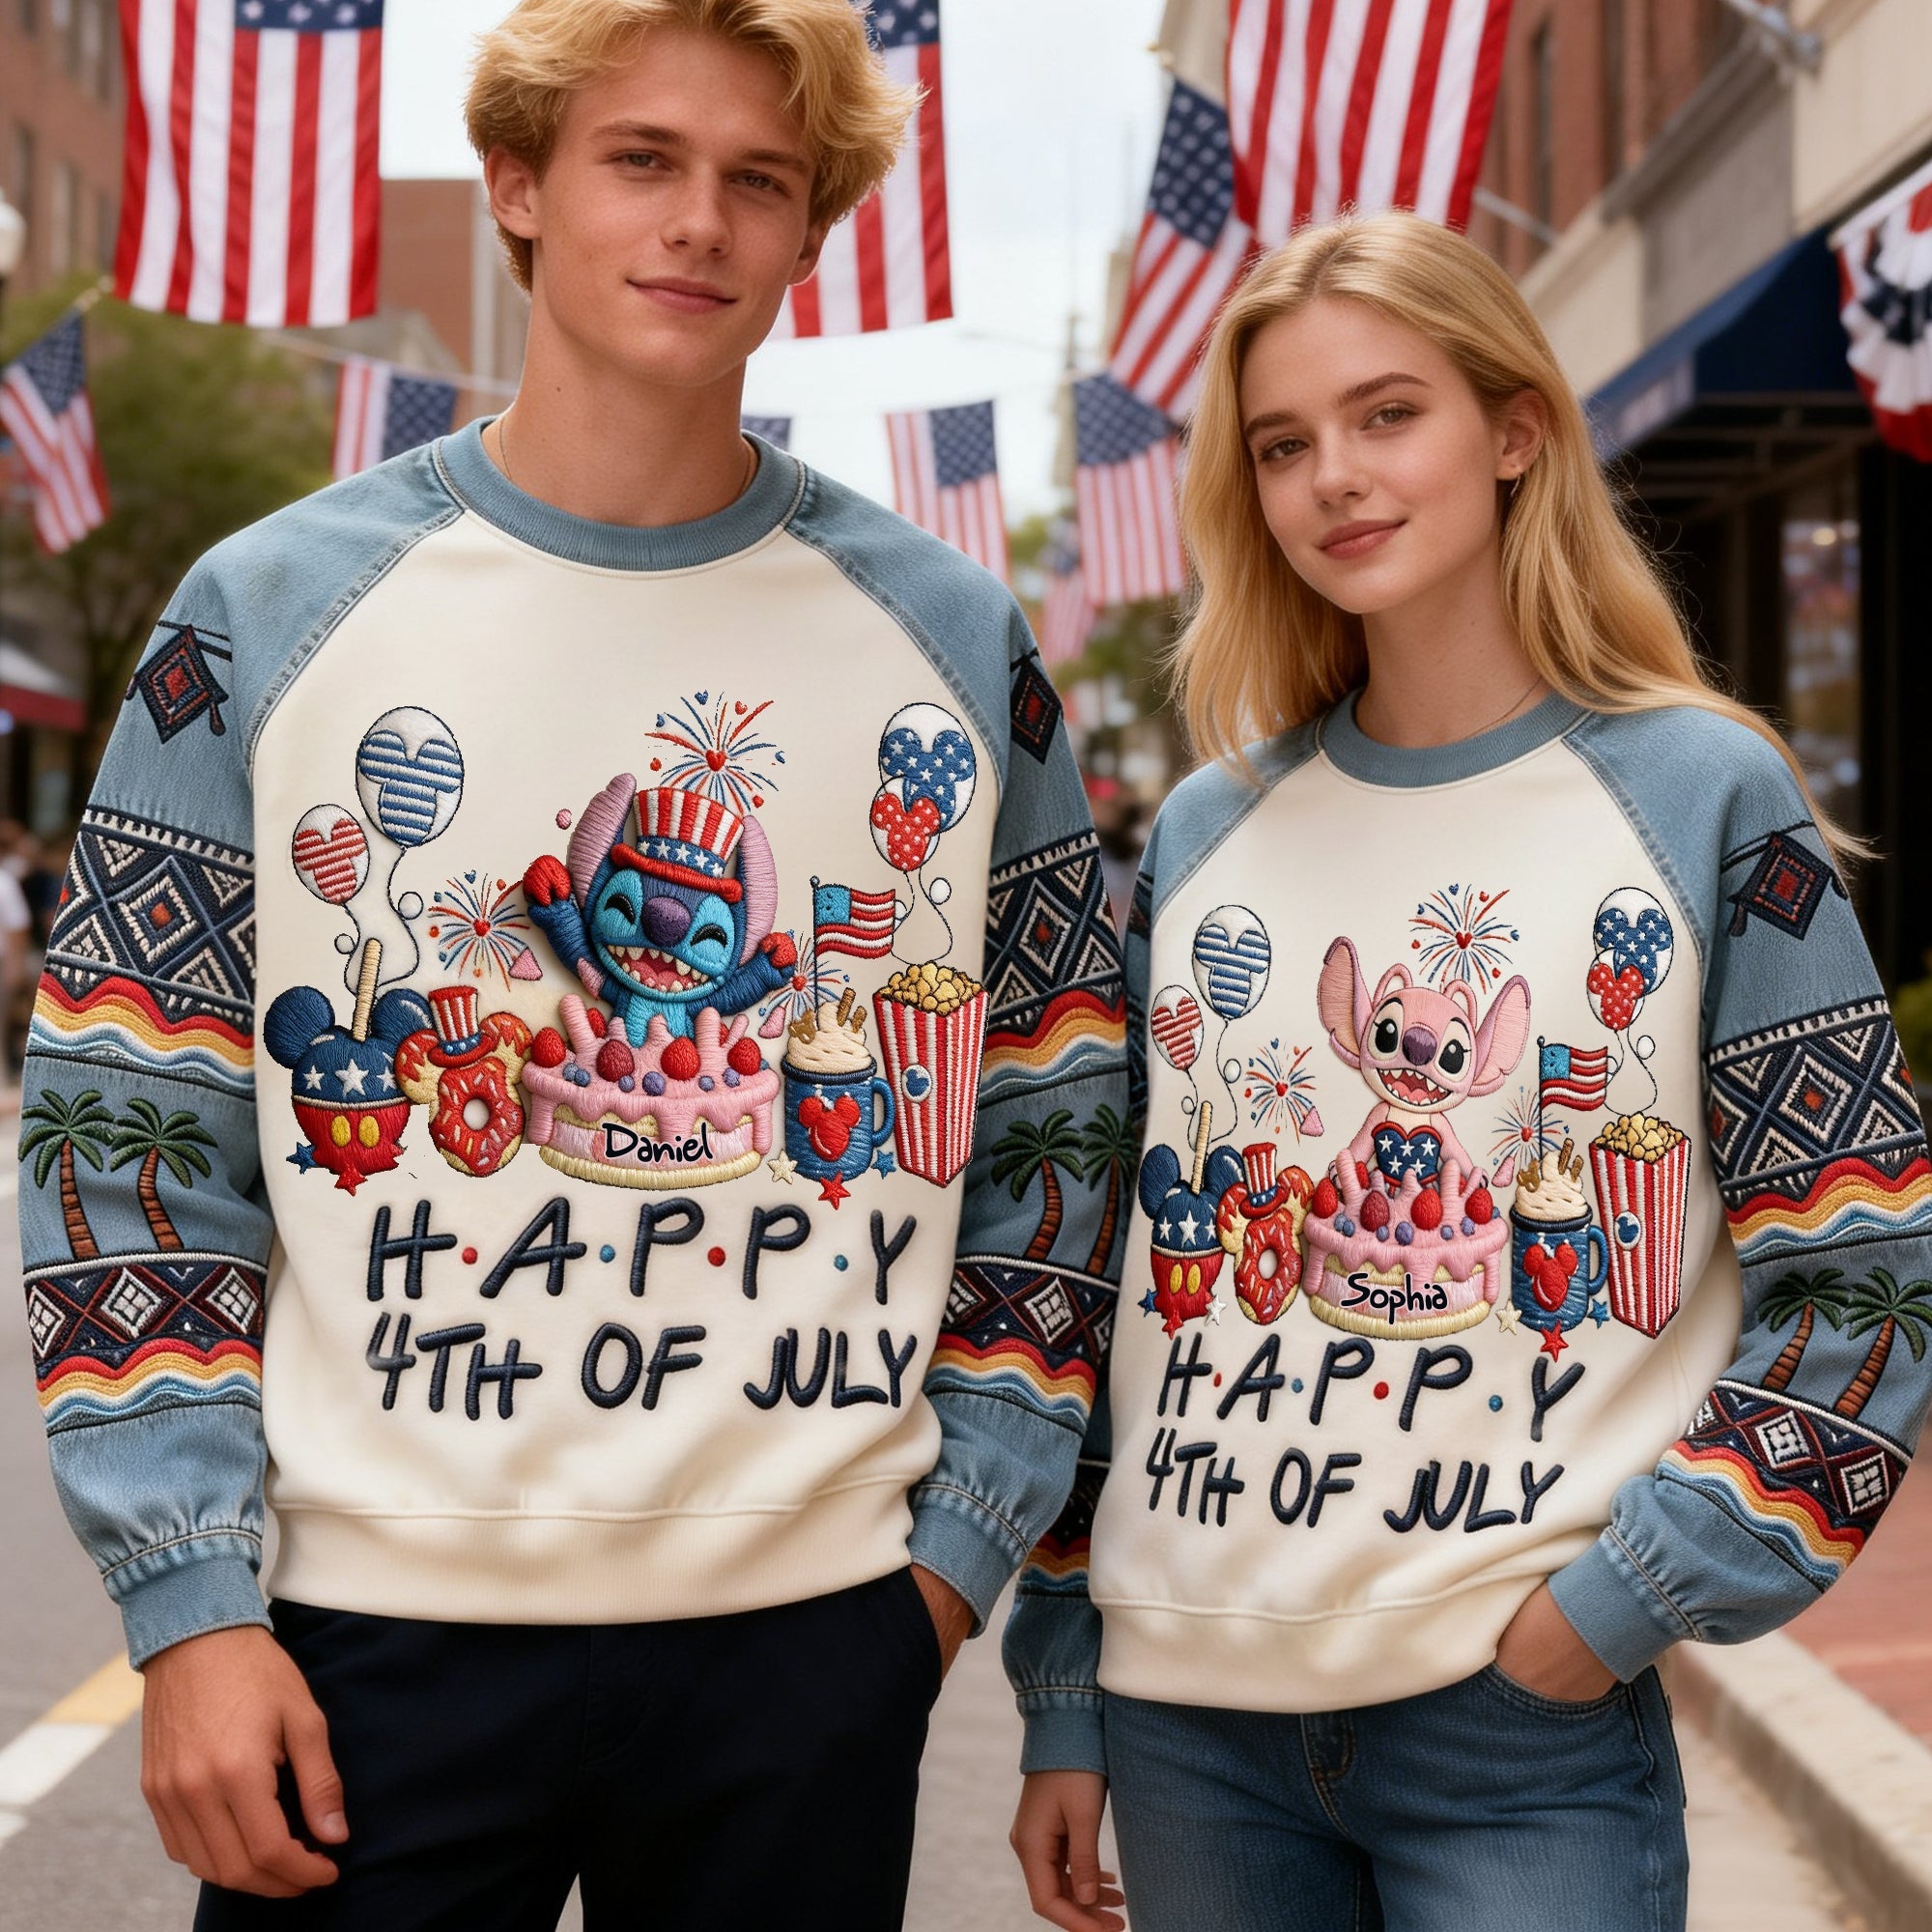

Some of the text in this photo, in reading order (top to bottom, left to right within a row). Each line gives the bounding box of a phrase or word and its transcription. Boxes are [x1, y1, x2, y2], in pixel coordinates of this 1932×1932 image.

[602, 1122, 714, 1163] Daniel
[1341, 1272, 1448, 1324] Sophia
[365, 1312, 918, 1421] 4TH OF JULY
[1146, 1427, 1564, 1533] 4TH OF JULY
